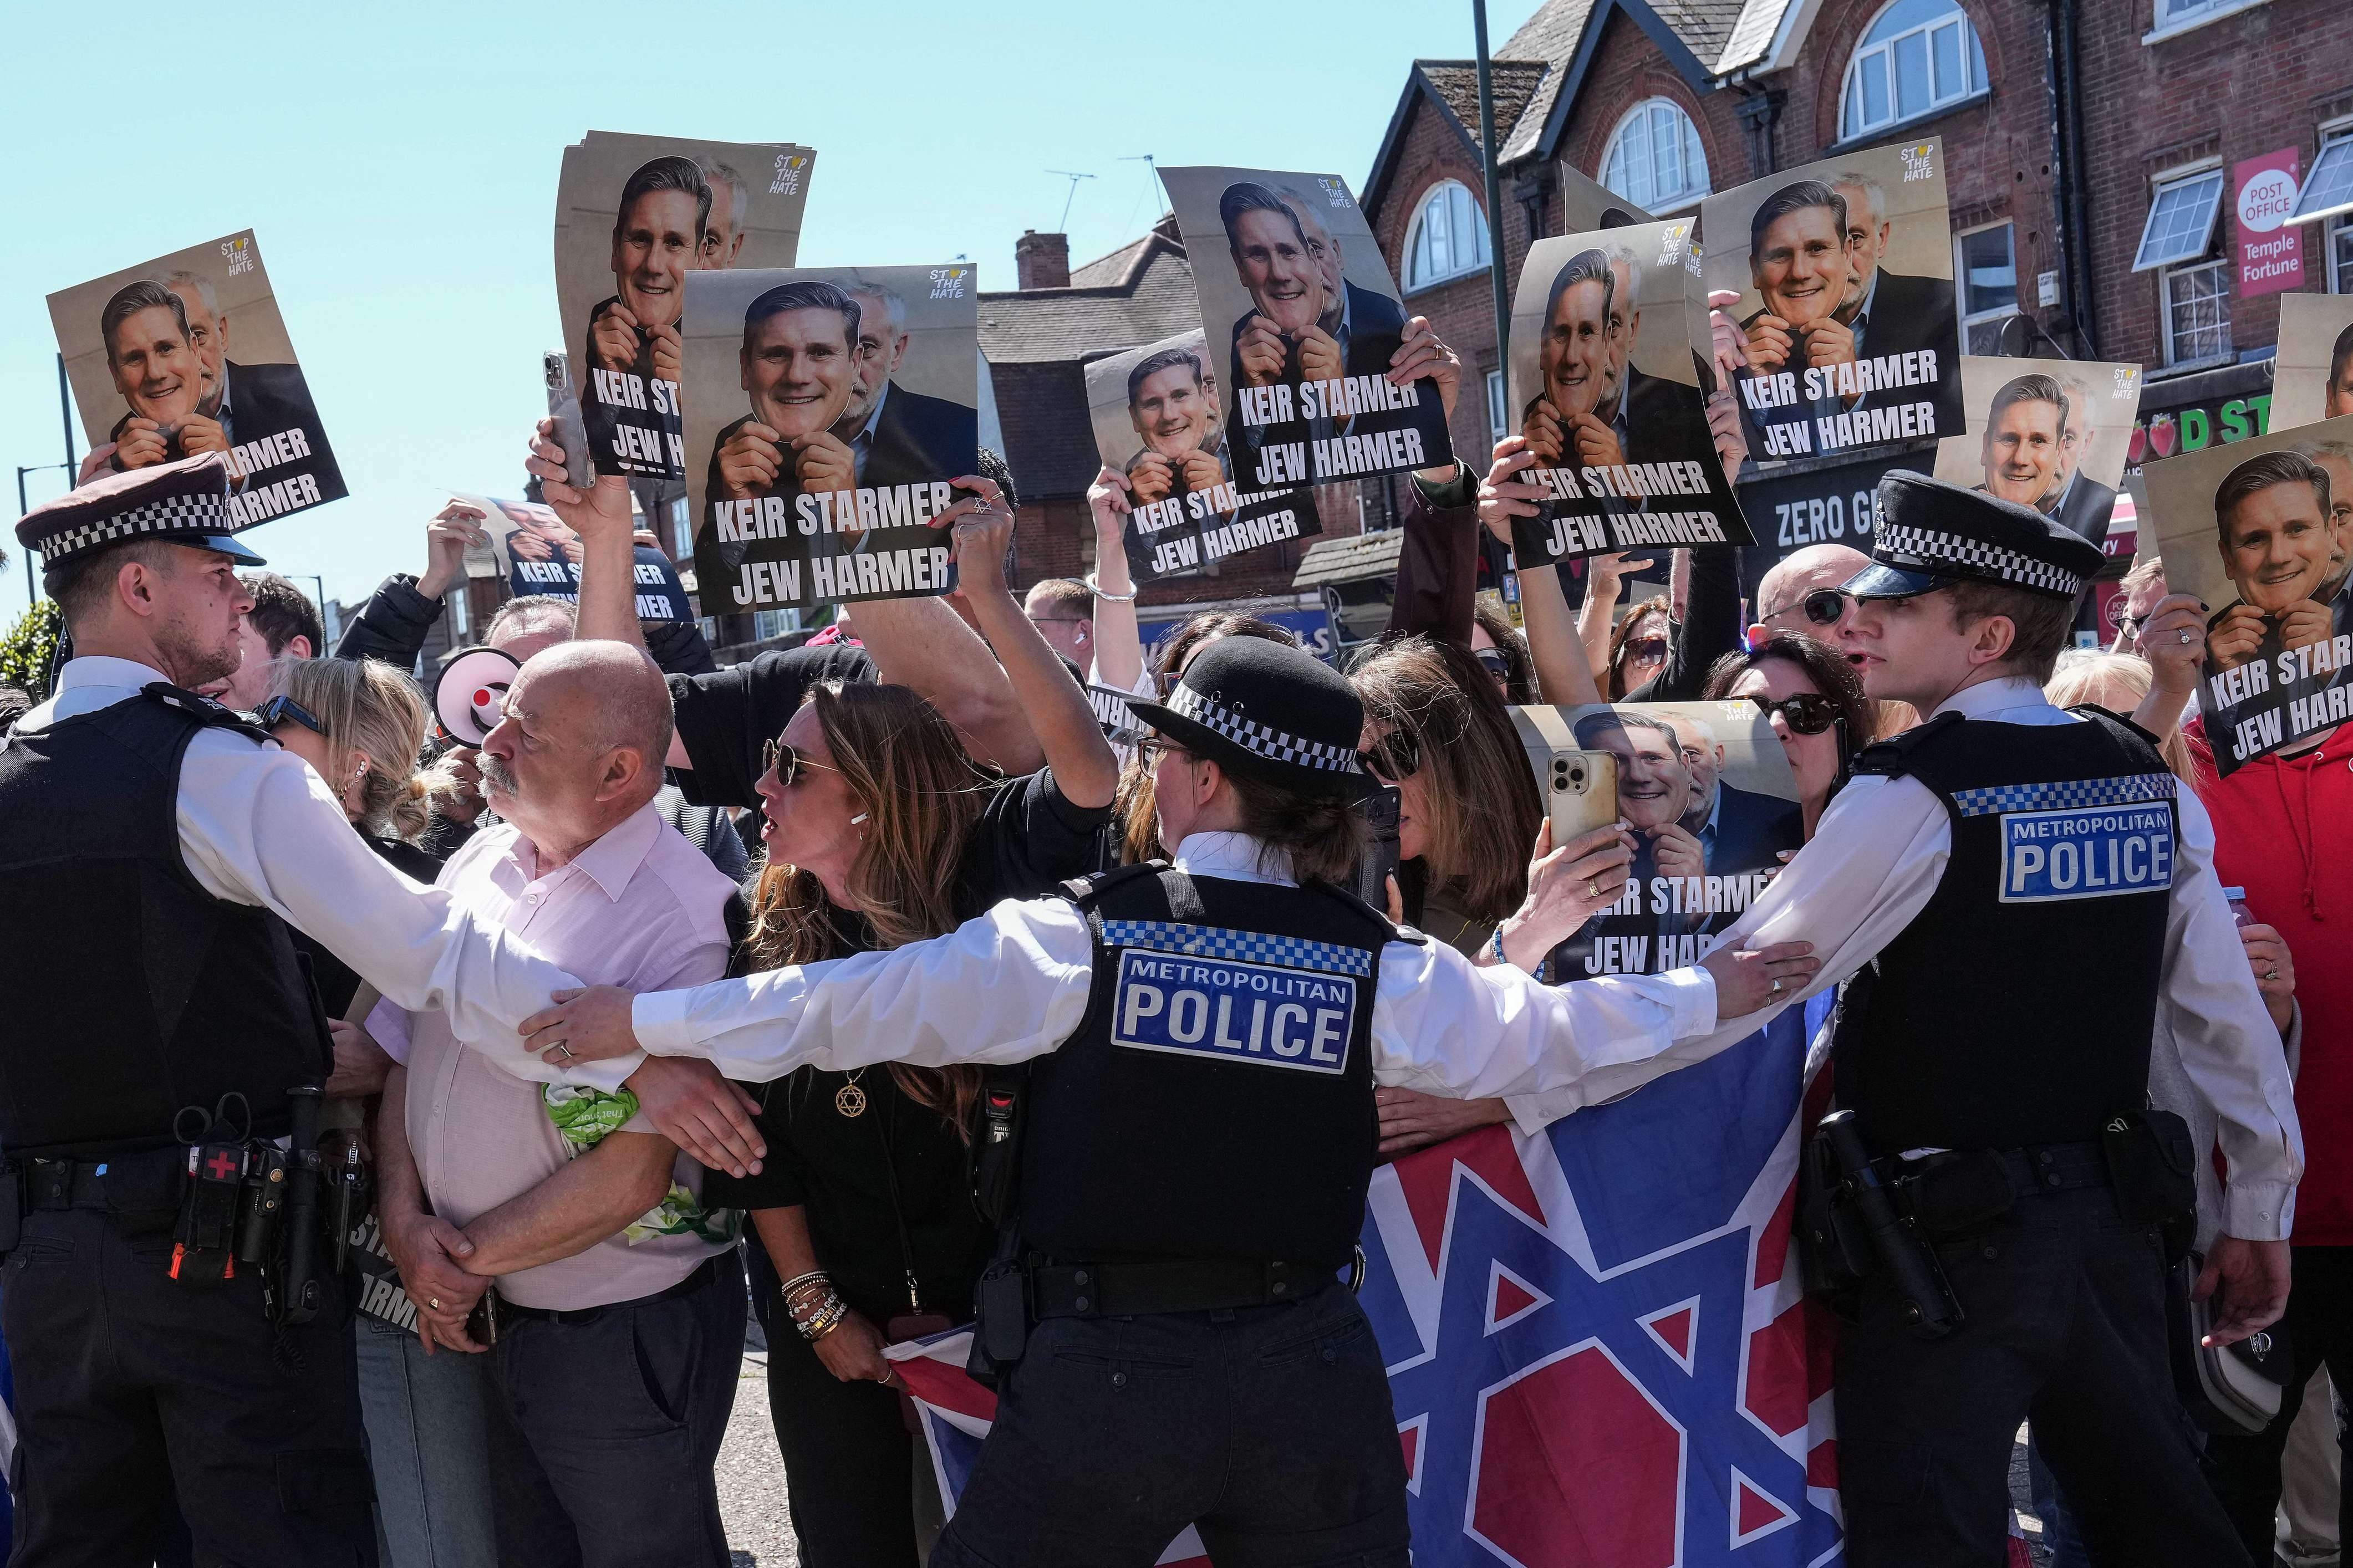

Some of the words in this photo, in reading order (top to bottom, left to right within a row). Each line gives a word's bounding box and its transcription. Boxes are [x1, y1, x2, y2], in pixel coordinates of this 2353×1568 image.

[777, 168, 800, 182] THE
[1903, 167, 1933, 182] HATE
[1906, 156, 1931, 170] THE
[769, 181, 799, 195] HATE
[1326, 188, 1344, 198] THE
[2250, 182, 2284, 203] POST
[1329, 198, 1352, 208] HATE
[2245, 197, 2290, 221] OFFICE
[227, 249, 249, 264] THE
[1663, 239, 1681, 253] THE
[2244, 234, 2295, 261] Temple
[228, 259, 254, 277] HATE
[1657, 252, 1680, 267] HATE
[1685, 262, 1702, 278] HATE
[1687, 252, 1701, 267] THE
[2243, 258, 2298, 282] Fortune
[930, 288, 964, 299] HATE
[934, 279, 962, 288] THE
[593, 367, 648, 411] KEIR
[1739, 372, 1798, 410] KEIR
[1804, 349, 1938, 401] STARMER
[2116, 379, 2133, 389] THE
[1238, 384, 1295, 427] KEIR
[2112, 389, 2133, 400] HATE
[1763, 420, 1812, 456] JEW
[1816, 401, 1936, 450] HARMER
[612, 423, 663, 464] JEW
[1255, 442, 1306, 485] JEW
[1312, 427, 1425, 478] HARMER
[1581, 461, 1712, 498] STARMER
[714, 497, 788, 543] KEIR
[795, 481, 953, 536] STARMER
[1133, 497, 1185, 535] KEIR
[1775, 495, 1845, 548] ZERO
[1152, 535, 1199, 573] JEW
[1203, 509, 1300, 560] HARMER
[1546, 514, 1608, 556] JEW
[1608, 511, 1727, 546] HARMER
[516, 561, 568, 583] KEIR
[732, 559, 801, 606] JEW
[811, 546, 949, 599] HARMER
[2209, 658, 2270, 712] KEIR
[2277, 633, 2353, 686] STAR
[2232, 707, 2283, 761] JEW
[2014, 813, 2168, 839] METROPOLITAN
[2011, 834, 2170, 892] POLICE
[1585, 936, 1649, 975] JEW
[1130, 959, 1347, 1004] METROPOLITAN
[1123, 983, 1344, 1063] POLICE
